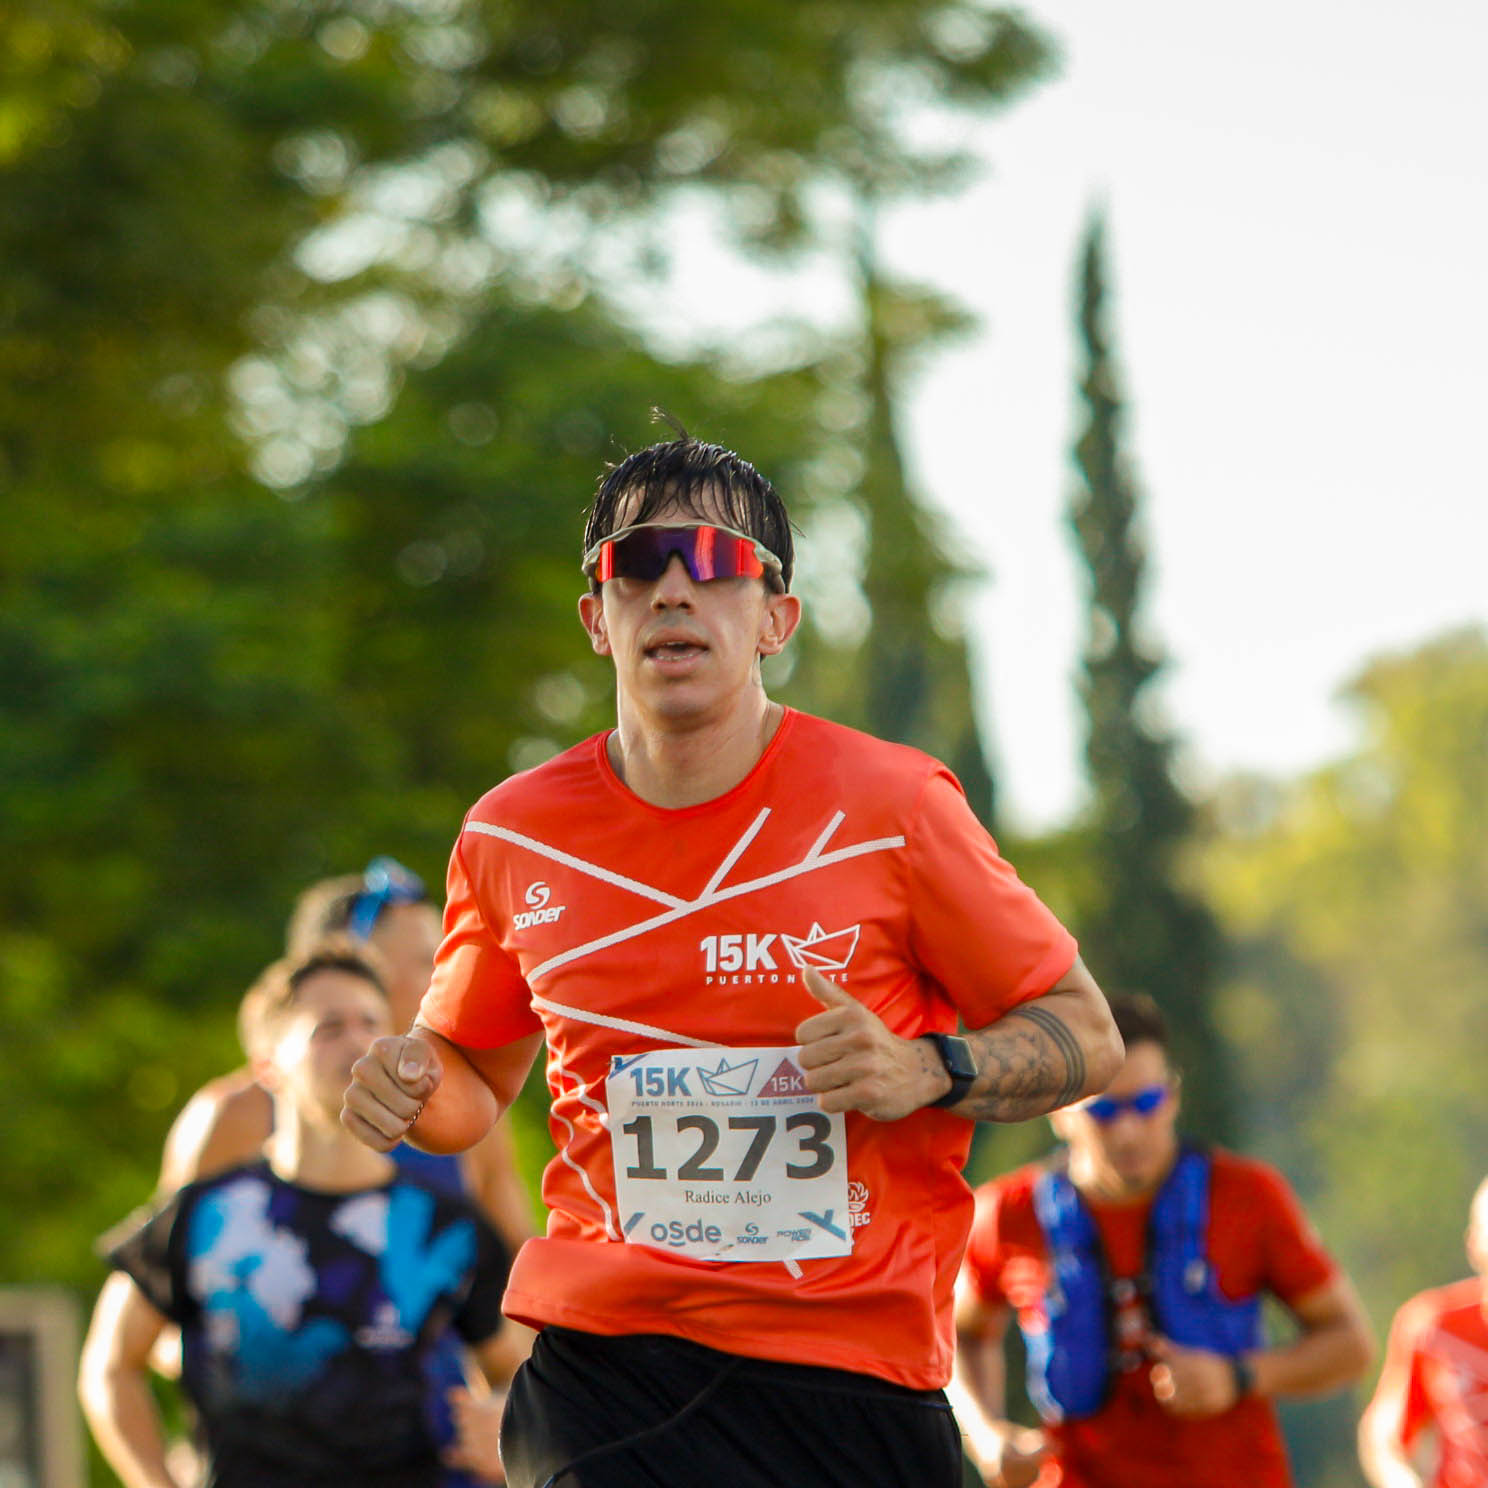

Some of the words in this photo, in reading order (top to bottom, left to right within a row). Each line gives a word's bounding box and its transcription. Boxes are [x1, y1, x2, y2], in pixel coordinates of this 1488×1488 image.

[700, 933, 780, 972] 15K
[706, 975, 778, 986] PUERTO
[787, 973, 849, 985] NTE
[631, 1067, 693, 1097] 15K
[771, 1077, 803, 1093] 15K
[623, 1111, 835, 1182] 1273
[685, 1190, 730, 1204] Radice
[734, 1190, 772, 1207] Alejo
[650, 1218, 722, 1246] osde
